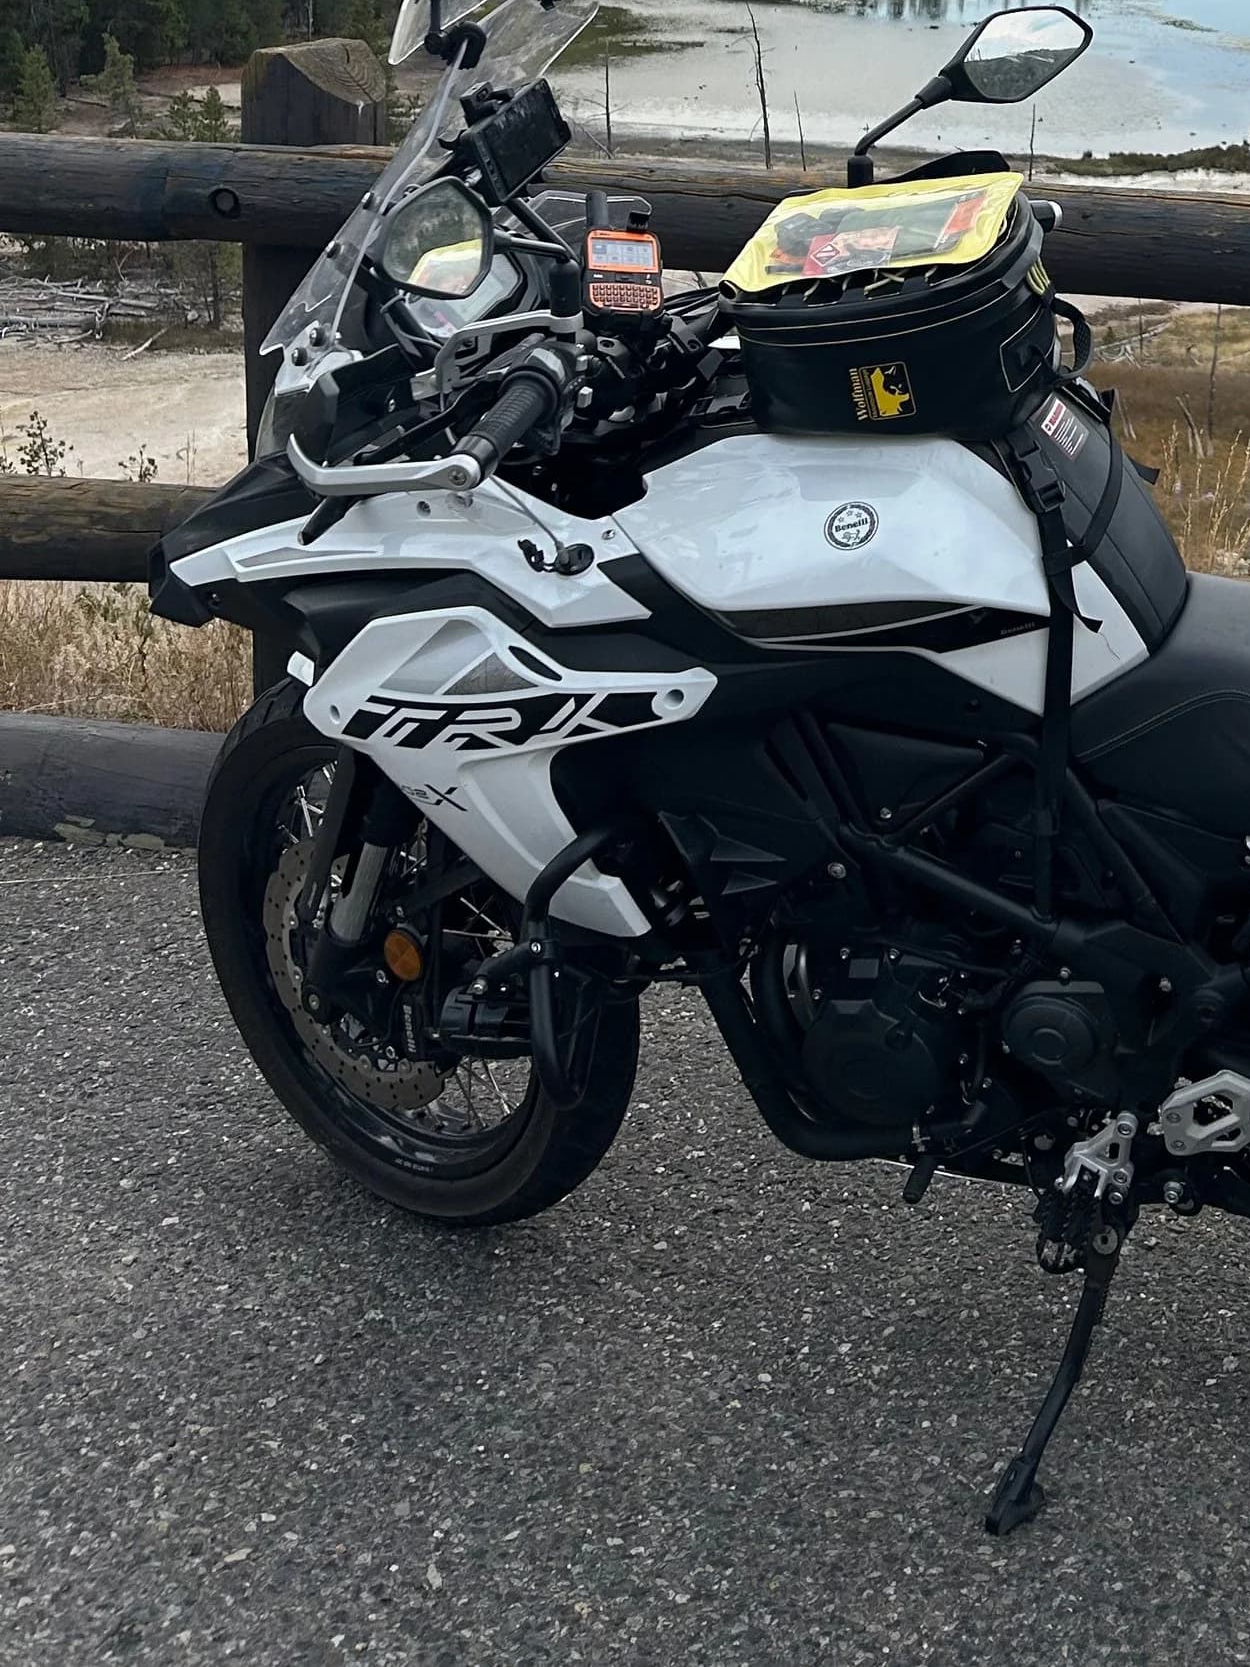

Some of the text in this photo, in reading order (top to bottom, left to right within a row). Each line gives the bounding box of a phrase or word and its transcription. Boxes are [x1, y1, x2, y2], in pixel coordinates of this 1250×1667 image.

[849, 368, 868, 421] Wolfman
[835, 518, 868, 532] Benelli
[343, 693, 650, 750] TRK
[403, 1004, 417, 1053] Benelli
